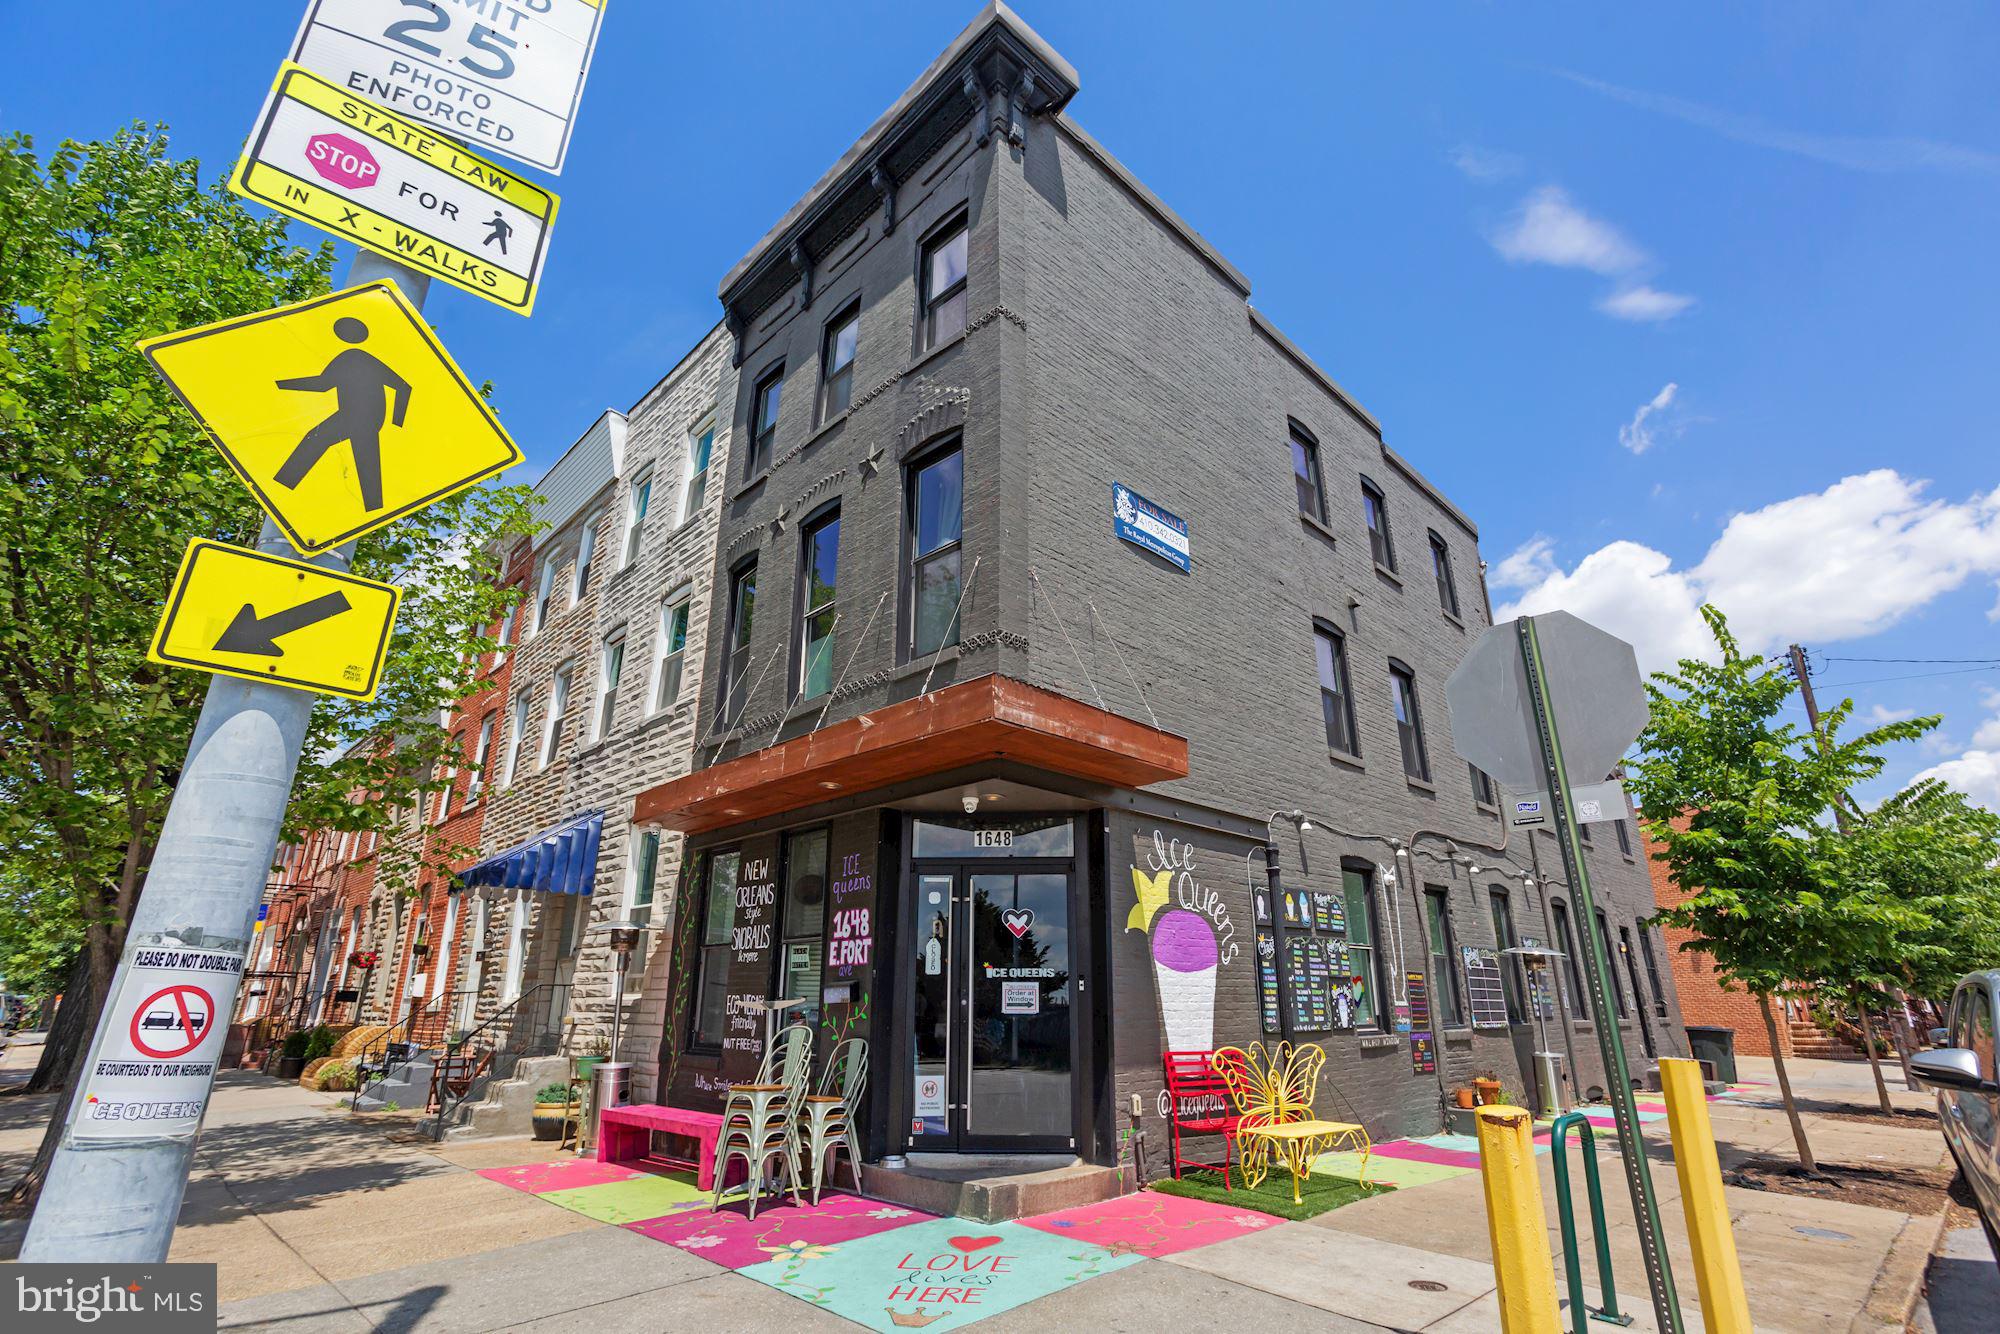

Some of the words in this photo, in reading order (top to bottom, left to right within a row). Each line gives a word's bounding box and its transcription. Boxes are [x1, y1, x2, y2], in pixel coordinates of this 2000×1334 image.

[383, 0, 517, 80] 25
[390, 60, 491, 110] PHOTO
[347, 71, 514, 142] ENFORCED
[340, 101, 435, 157] STATE
[451, 155, 509, 192] LAW
[310, 141, 376, 180] STOP
[285, 184, 309, 204] IN
[398, 181, 460, 221] FOR
[976, 831, 1011, 846] 1648
[744, 858, 769, 881] NEW
[842, 854, 860, 877] ICE
[735, 883, 775, 908] ORLEANS
[833, 875, 871, 903] queens
[1147, 830, 1196, 871] Ice
[1178, 871, 1239, 965] Queens
[833, 908, 869, 938] 1648
[731, 924, 771, 950] SNOBALLS
[134, 951, 164, 966] PLEASE
[165, 952, 179, 967] DO
[180, 953, 200, 968] NOT
[199, 954, 230, 971] DOUBLE
[1008, 967, 1055, 978] QUEENS
[731, 1016, 757, 1037] friendly
[723, 1037, 736, 1049] NUT
[736, 1037, 750, 1050] FREE
[96, 1063, 104, 1075] BE
[103, 1064, 150, 1076] COURTEOUS
[150, 1064, 162, 1076] TO
[162, 1064, 179, 1076] OUR
[123, 1101, 201, 1122] QUEENS
[897, 1253, 1020, 1272] LOVE
[896, 1270, 998, 1285] lives
[888, 1285, 987, 1304] HERE
